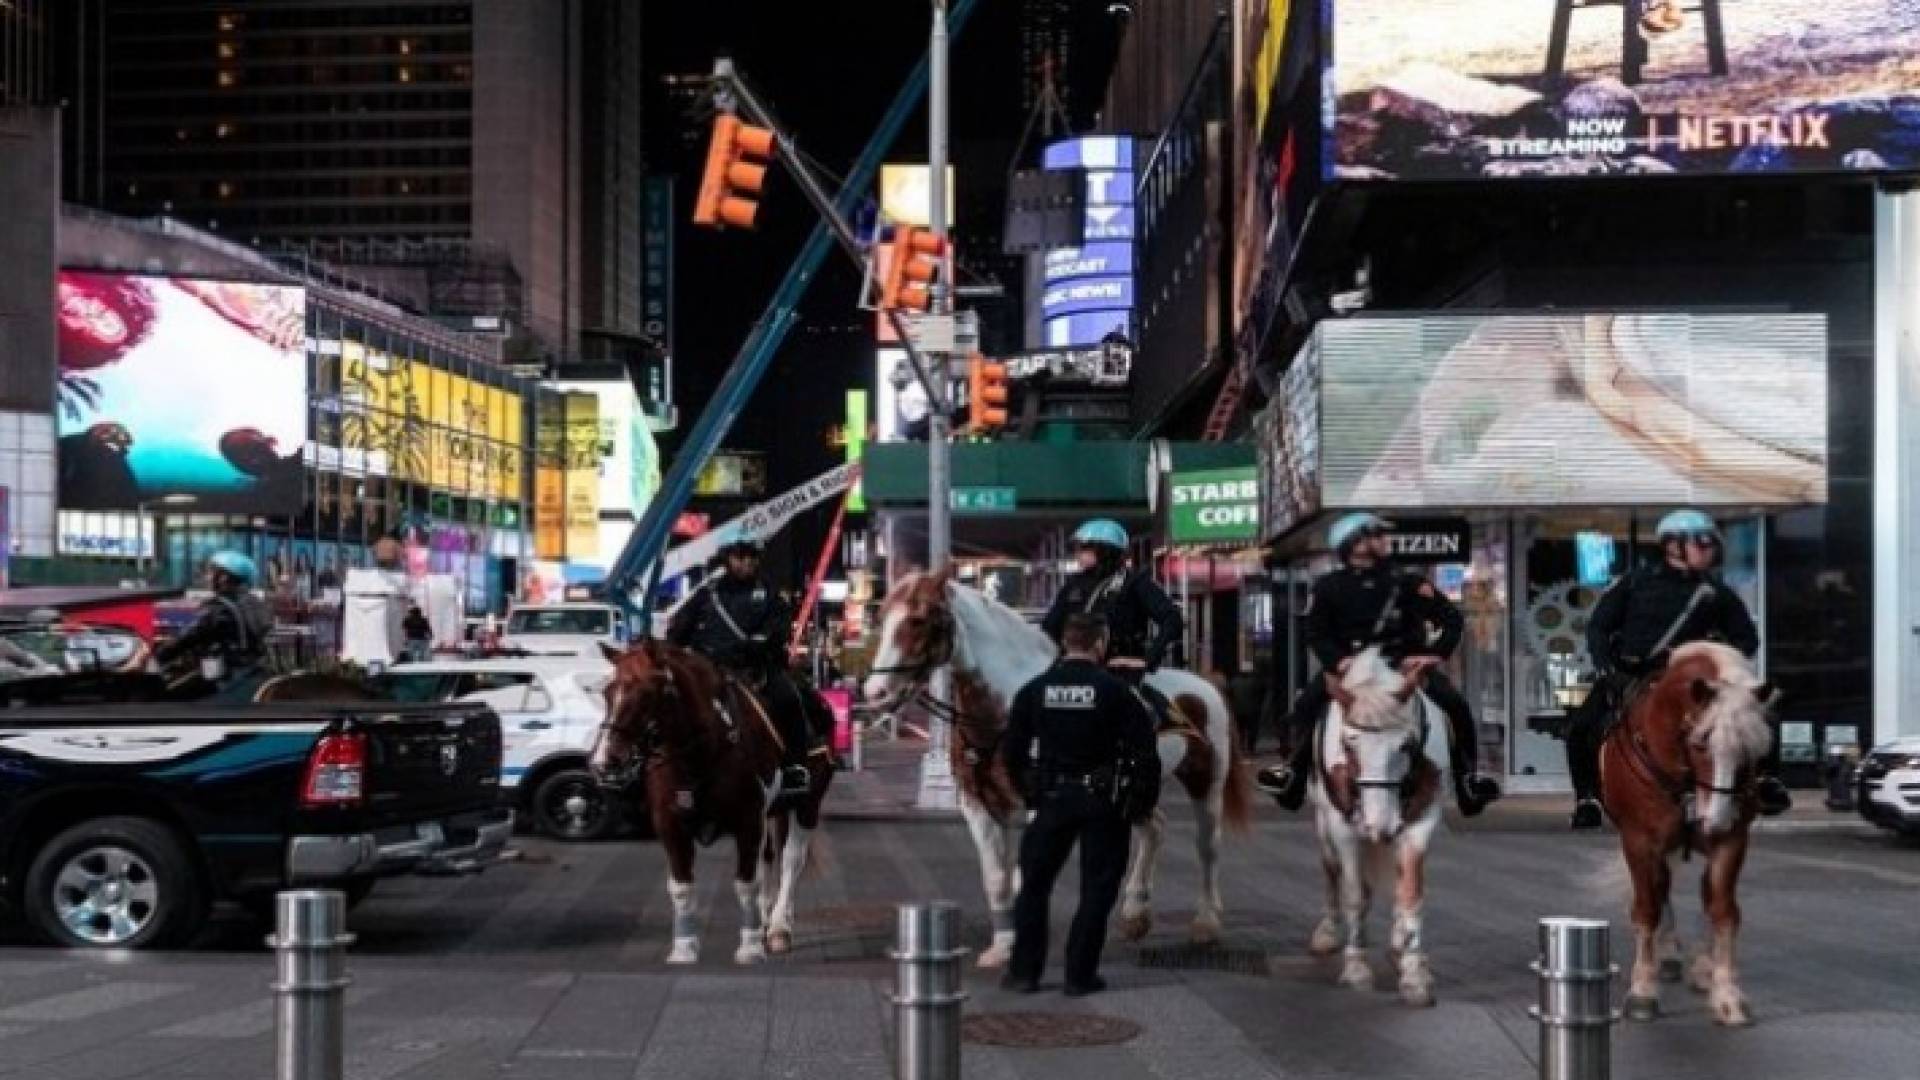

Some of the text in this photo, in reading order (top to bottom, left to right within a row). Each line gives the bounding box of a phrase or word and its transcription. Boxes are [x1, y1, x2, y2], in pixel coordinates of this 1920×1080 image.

[1568, 119, 1626, 136] NOW
[1680, 114, 1831, 151] NETFLIX
[1488, 138, 1627, 156] STREAMING
[1045, 685, 1095, 704] NYPD
